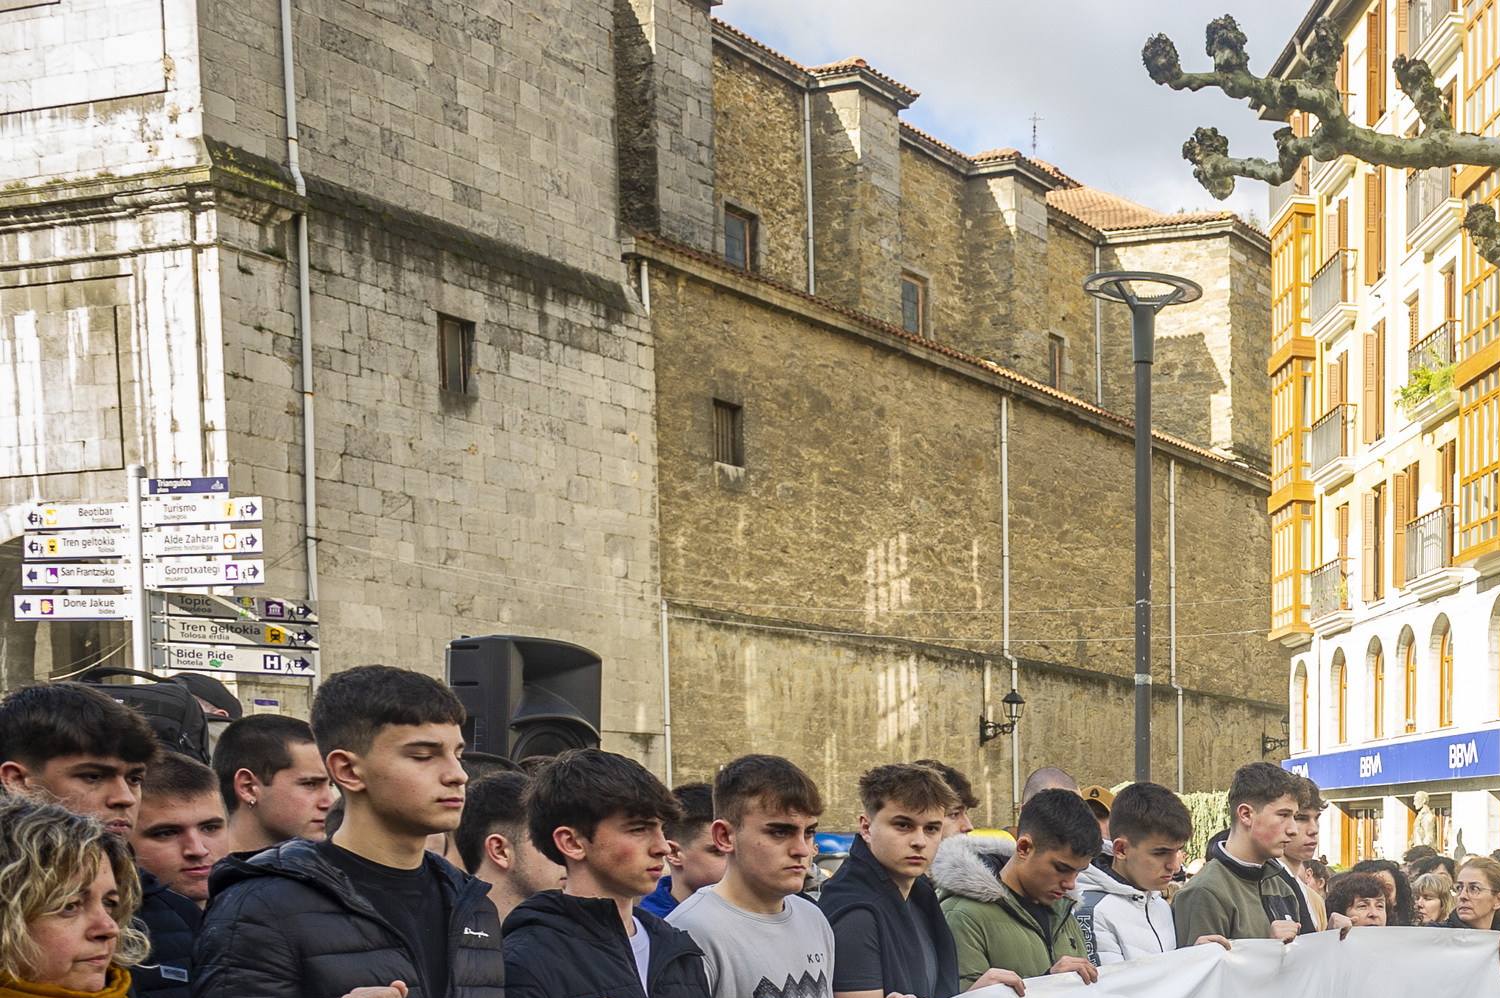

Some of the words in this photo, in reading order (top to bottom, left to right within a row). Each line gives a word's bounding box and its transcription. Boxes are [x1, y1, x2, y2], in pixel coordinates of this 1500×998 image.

[157, 479, 191, 489] Trianguloa
[78, 507, 113, 517] Beotibar
[163, 504, 197, 513] Turismo
[62, 538, 80, 547] Tren
[82, 537, 115, 548] geltokia
[164, 535, 183, 544] Alde
[185, 534, 219, 544] Zaharra
[61, 567, 75, 576] San
[76, 567, 115, 576] Frantzisko
[165, 565, 220, 576] Gorrotxategi
[63, 599, 87, 607] Done
[89, 598, 115, 608] Jakue
[179, 596, 212, 607] Topic
[179, 606, 212, 614] museoa
[180, 622, 206, 632] Tren
[210, 624, 261, 635] geltokia
[176, 649, 203, 659] Bide
[1449, 739, 1479, 769] BBVA
[1359, 752, 1382, 778] BBVA
